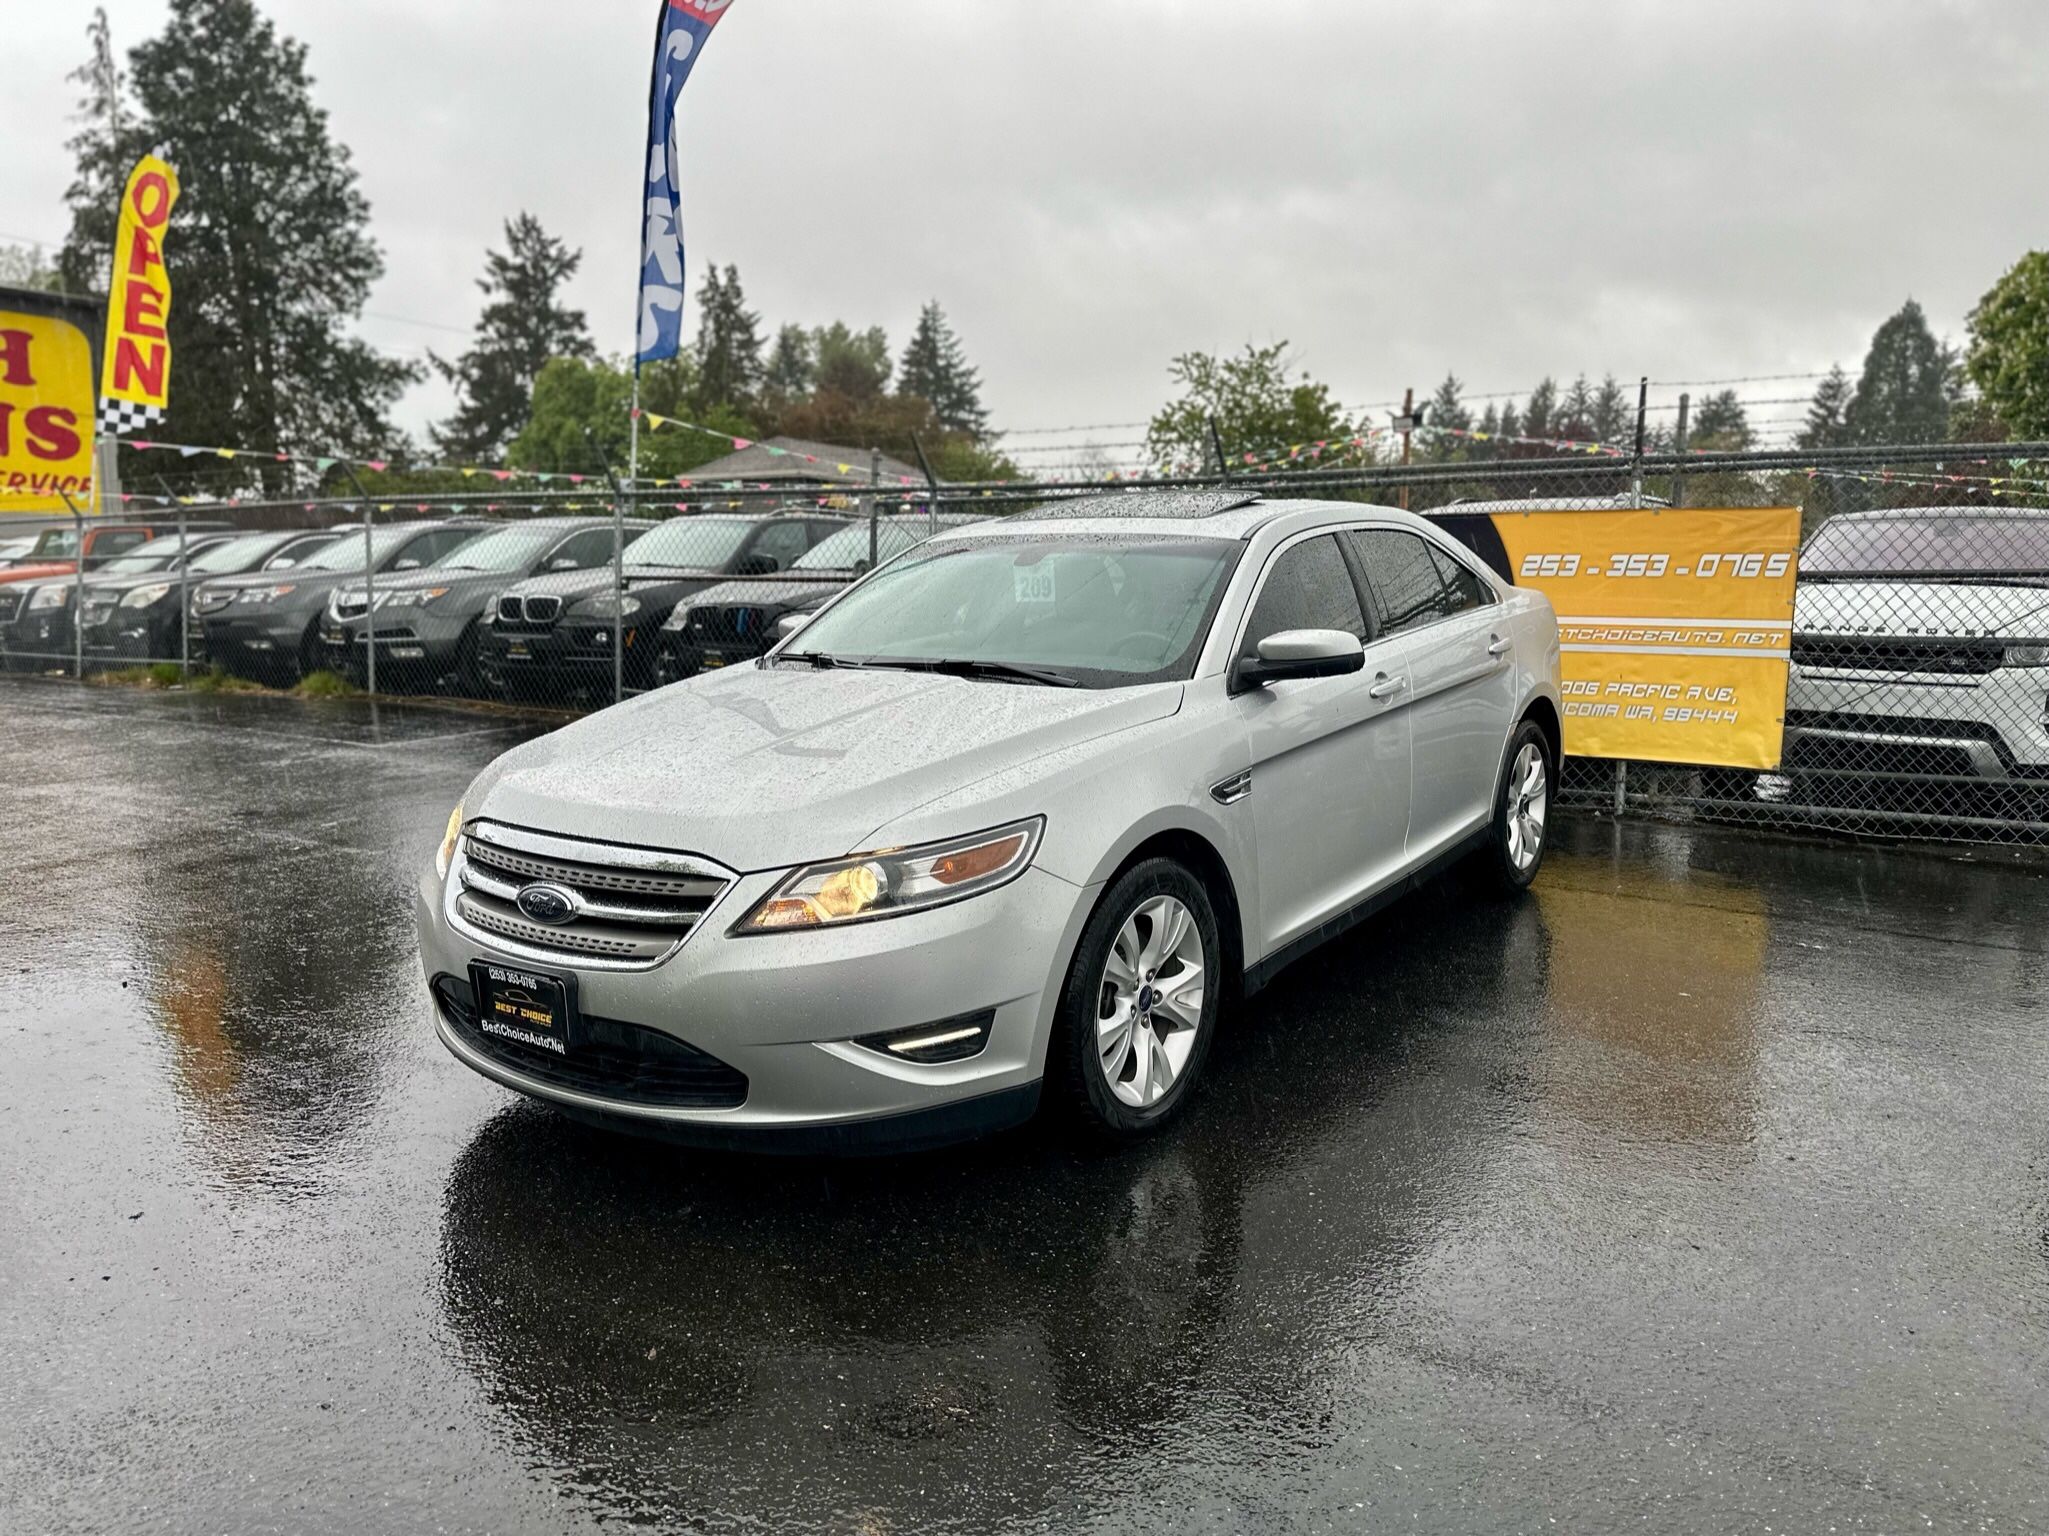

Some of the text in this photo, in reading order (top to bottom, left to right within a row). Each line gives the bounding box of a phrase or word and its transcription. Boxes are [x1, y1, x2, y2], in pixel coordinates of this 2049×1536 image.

[113, 171, 170, 398] OPEN
[1519, 553, 1582, 577] 253
[1604, 553, 1670, 577] 353
[1604, 682, 1681, 699] PACFIC
[1561, 702, 1738, 725] COMA WA, 98444
[526, 892, 556, 915] Ford
[495, 1001, 517, 1014] BEST
[520, 1008, 552, 1024] CHOICE
